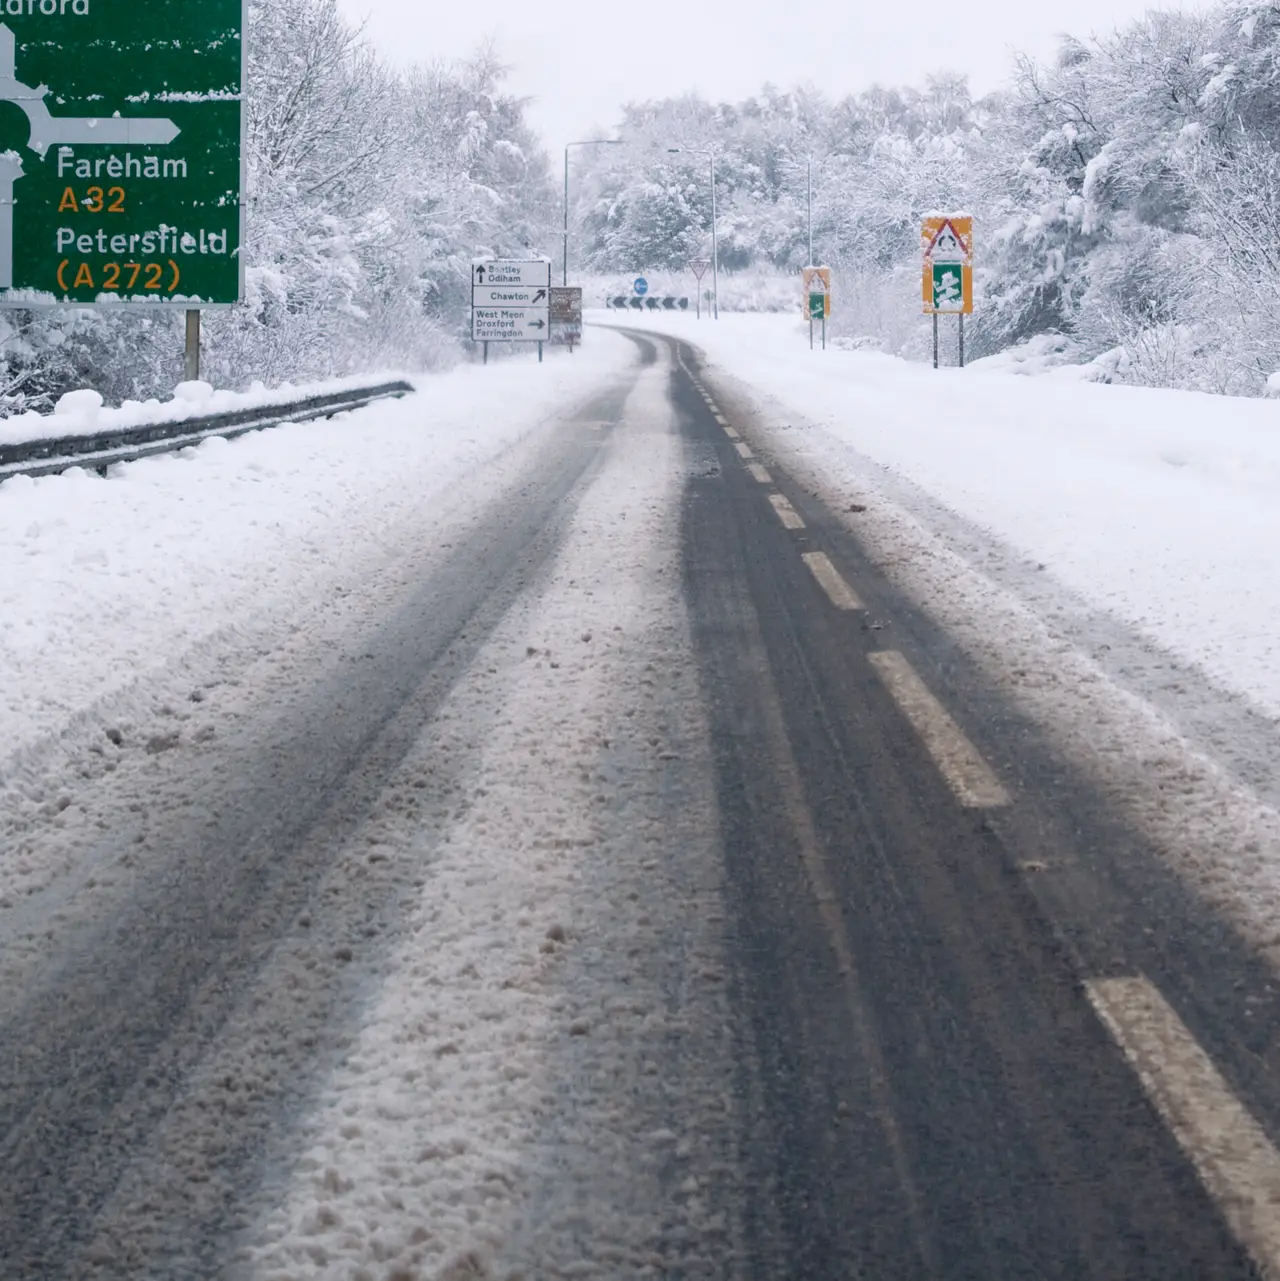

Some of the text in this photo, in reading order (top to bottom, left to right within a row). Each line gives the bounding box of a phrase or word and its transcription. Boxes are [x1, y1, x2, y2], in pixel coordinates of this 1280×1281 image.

[57, 152, 188, 178] Fareham
[56, 227, 227, 253] Petersfield
[488, 274, 521, 282] Odiham
[490, 292, 529, 300] Chawton
[476, 310, 525, 319] West Meon
[476, 320, 515, 328] Droxford
[476, 329, 523, 338] Farringdon
